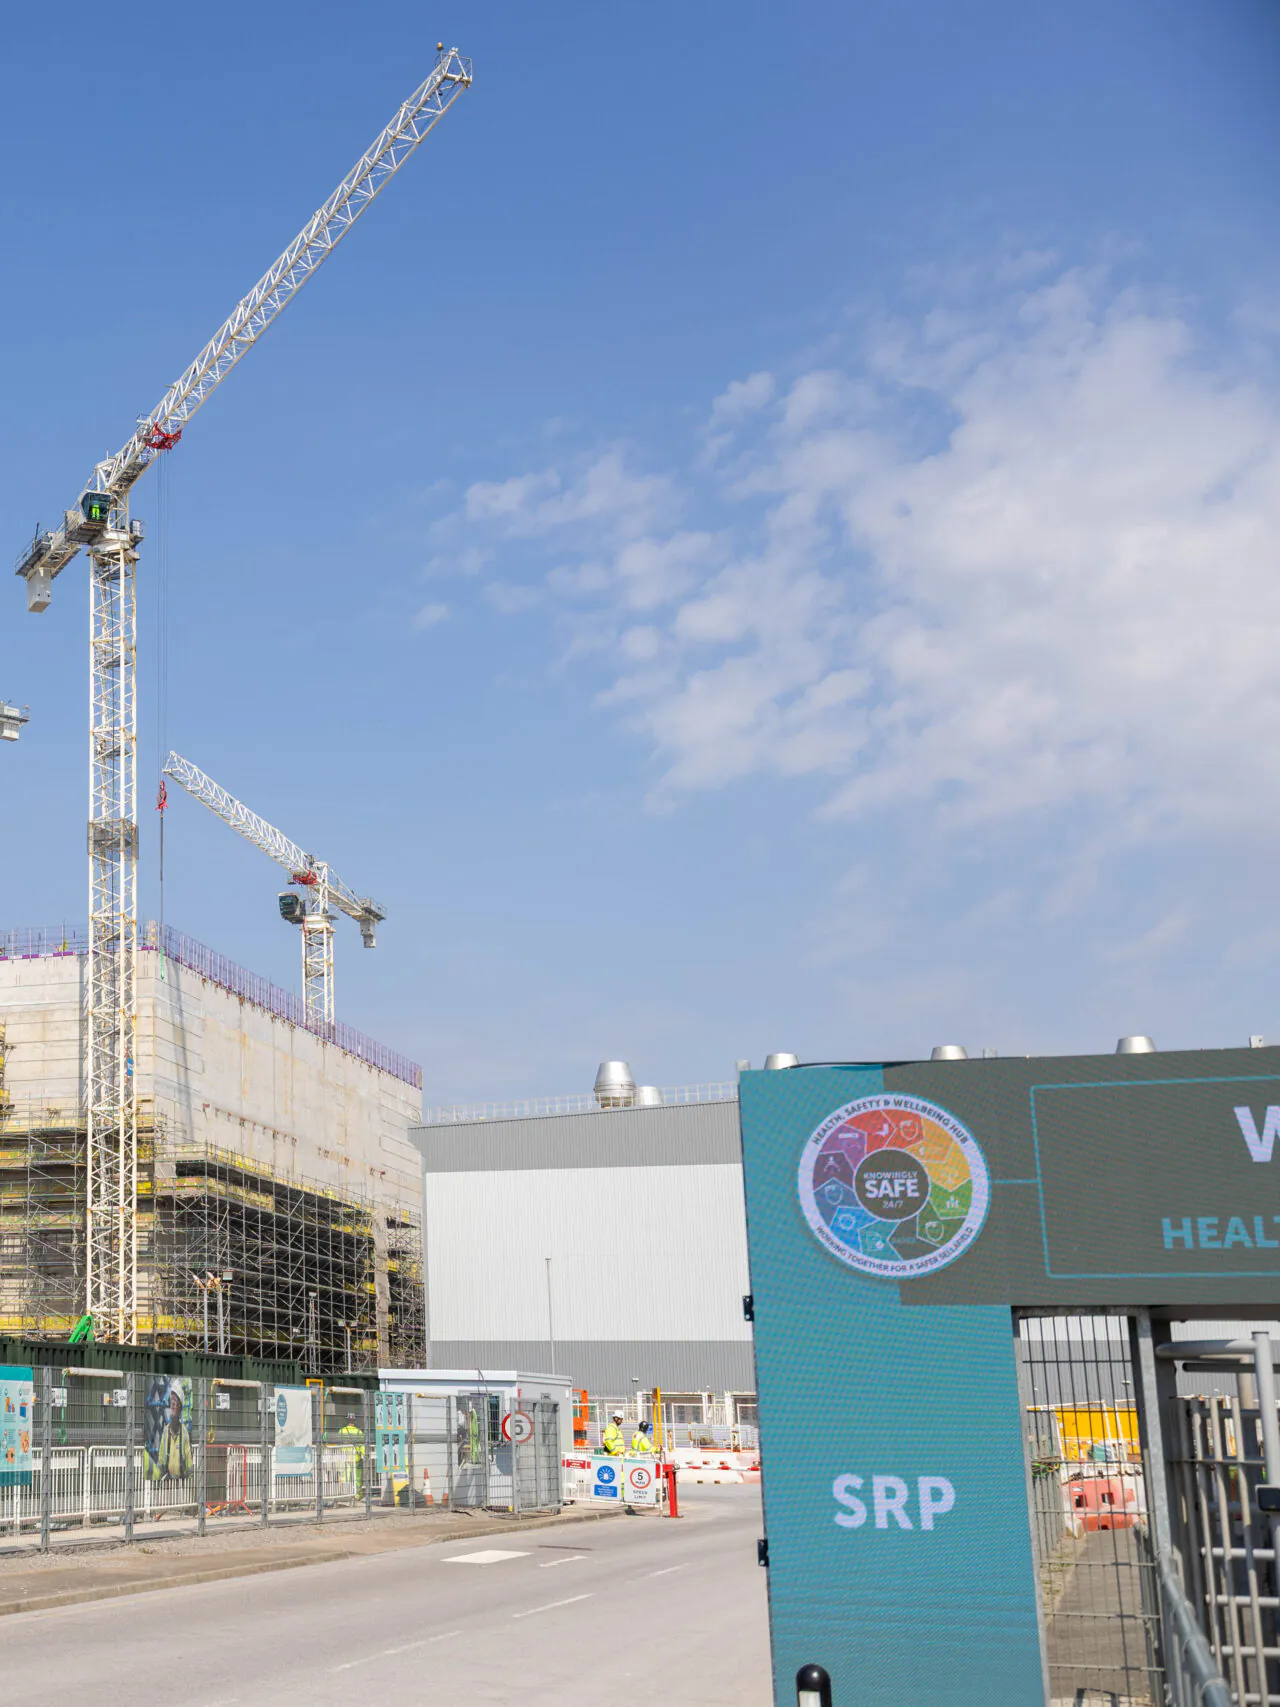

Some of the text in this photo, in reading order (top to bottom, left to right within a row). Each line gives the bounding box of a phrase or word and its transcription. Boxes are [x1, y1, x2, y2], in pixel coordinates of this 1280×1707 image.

[812, 1098, 969, 1146] HEALTH, SAFETY & WELLBEING HUB
[1233, 1105, 1280, 1162] W
[863, 1171, 918, 1180] KNOWINGLY
[865, 1179, 920, 1198] SAFE
[882, 1200, 904, 1209] 24/7
[815, 1225, 847, 1259] WORKING
[848, 1252, 889, 1272] TOGETHER
[914, 1257, 939, 1270] SAFER
[513, 1420, 524, 1435] 5
[637, 1472, 644, 1481] 5
[832, 1473, 957, 1531] SRP
